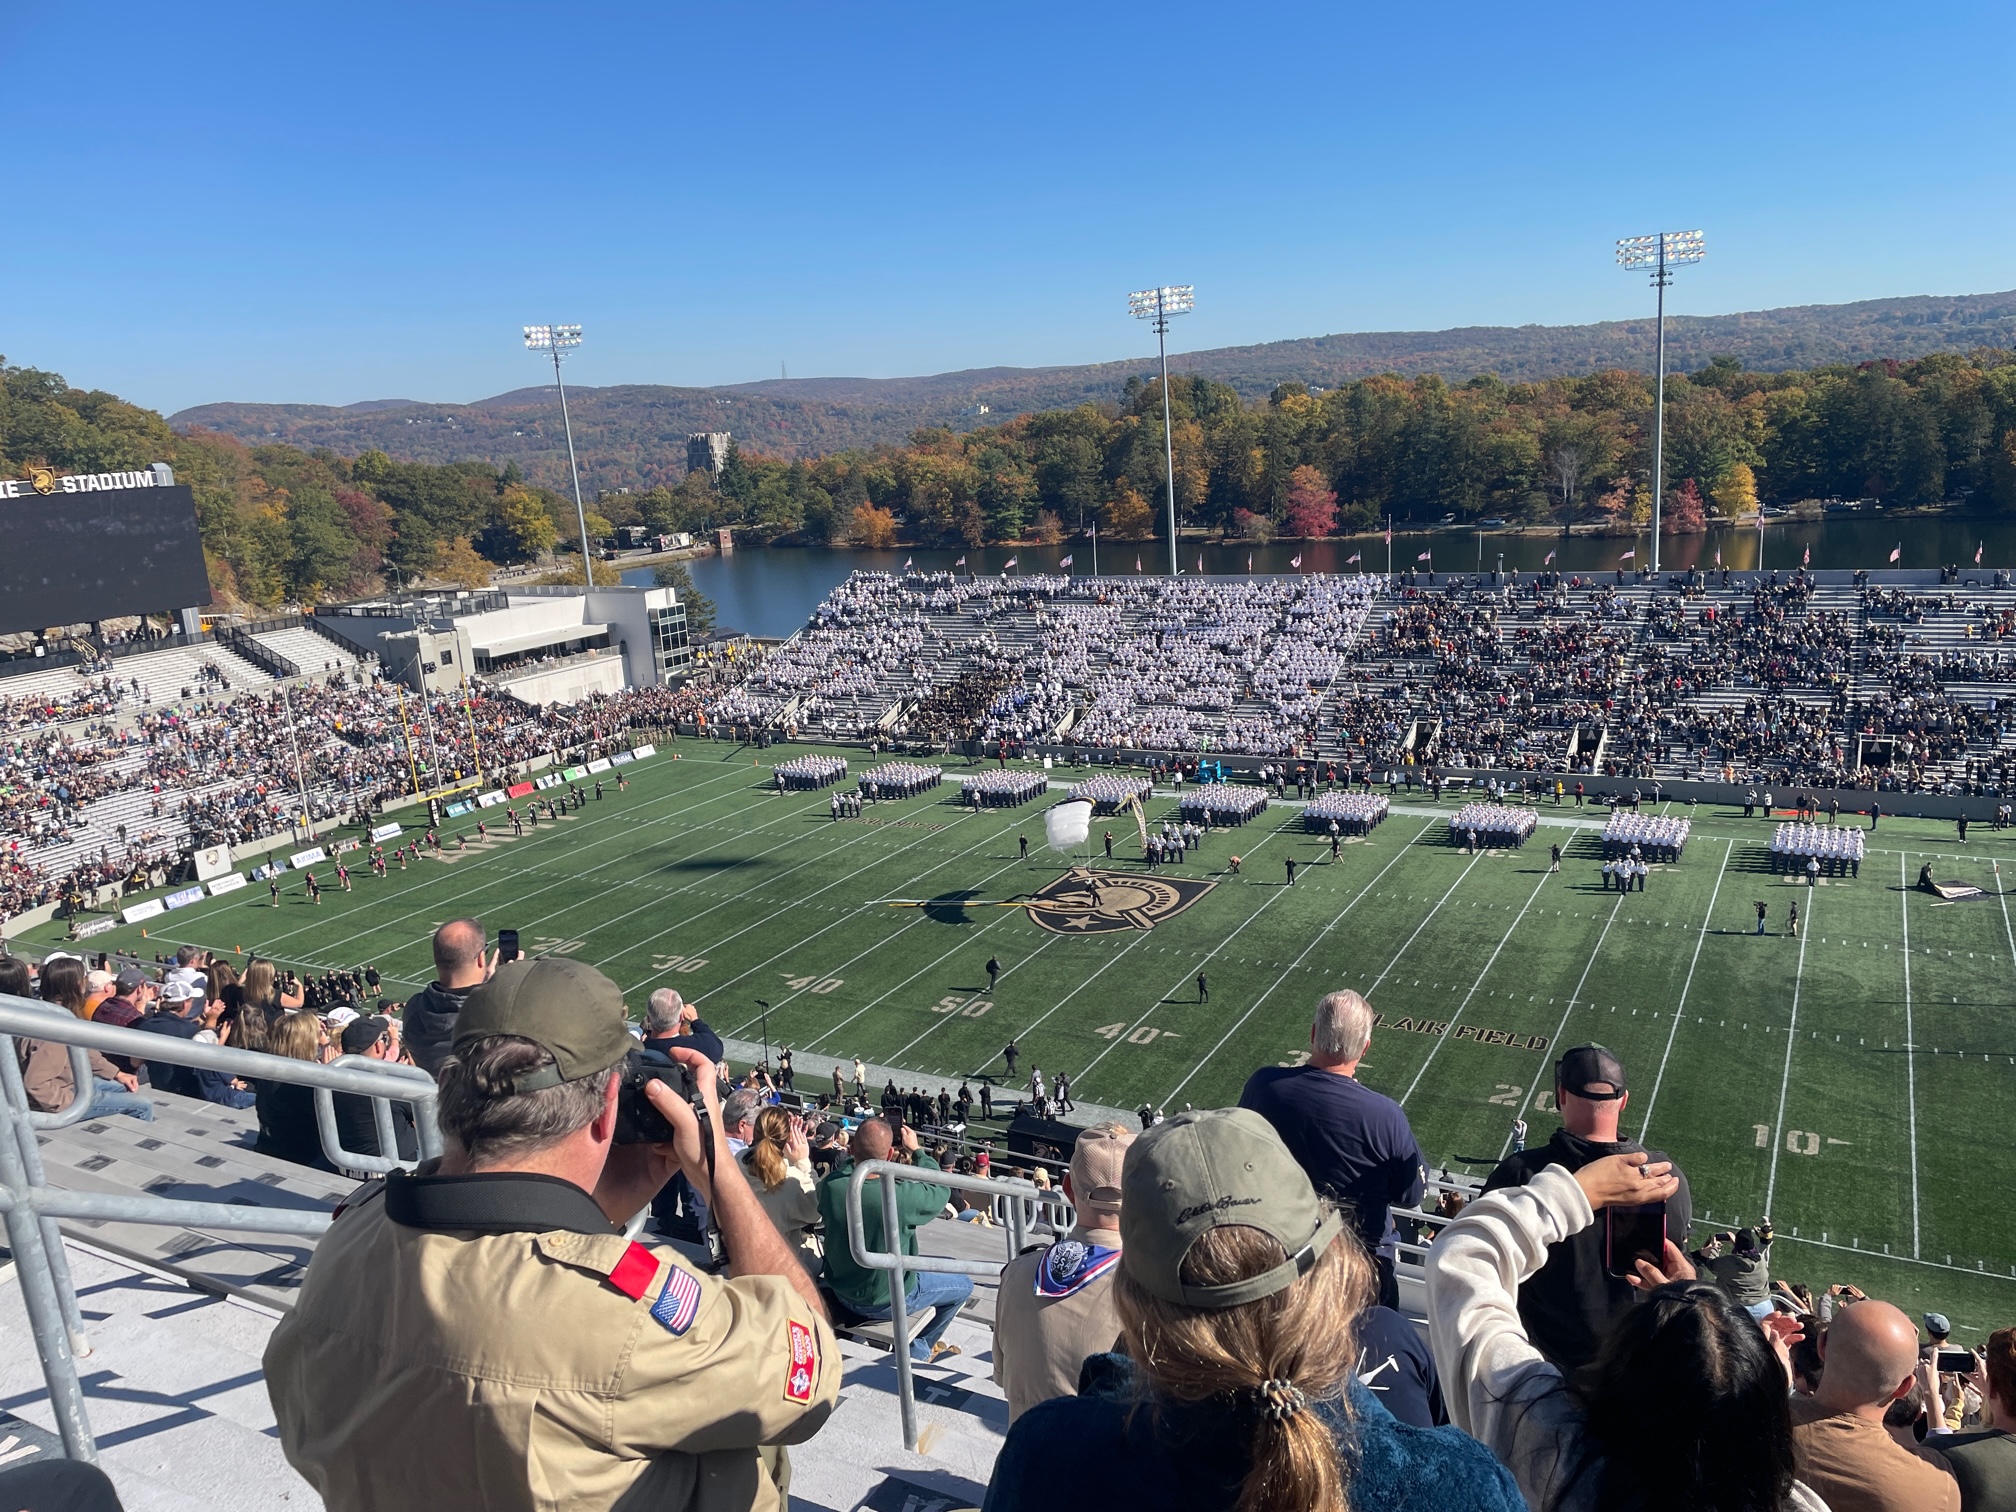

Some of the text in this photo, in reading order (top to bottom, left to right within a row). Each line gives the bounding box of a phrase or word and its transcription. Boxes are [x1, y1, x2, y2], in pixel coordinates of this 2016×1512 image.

[62, 471, 154, 493] STADIUM
[295, 850, 323, 864] AKIMA
[530, 937, 587, 955] 20
[652, 955, 710, 973] 30
[785, 975, 845, 994] 40
[931, 996, 995, 1018] 50
[1094, 1022, 1161, 1045] 40
[1373, 1013, 1550, 1051] LAIK FIELD
[1752, 1124, 1821, 1156] 10
[1215, 1195, 1262, 1210] Bauer
